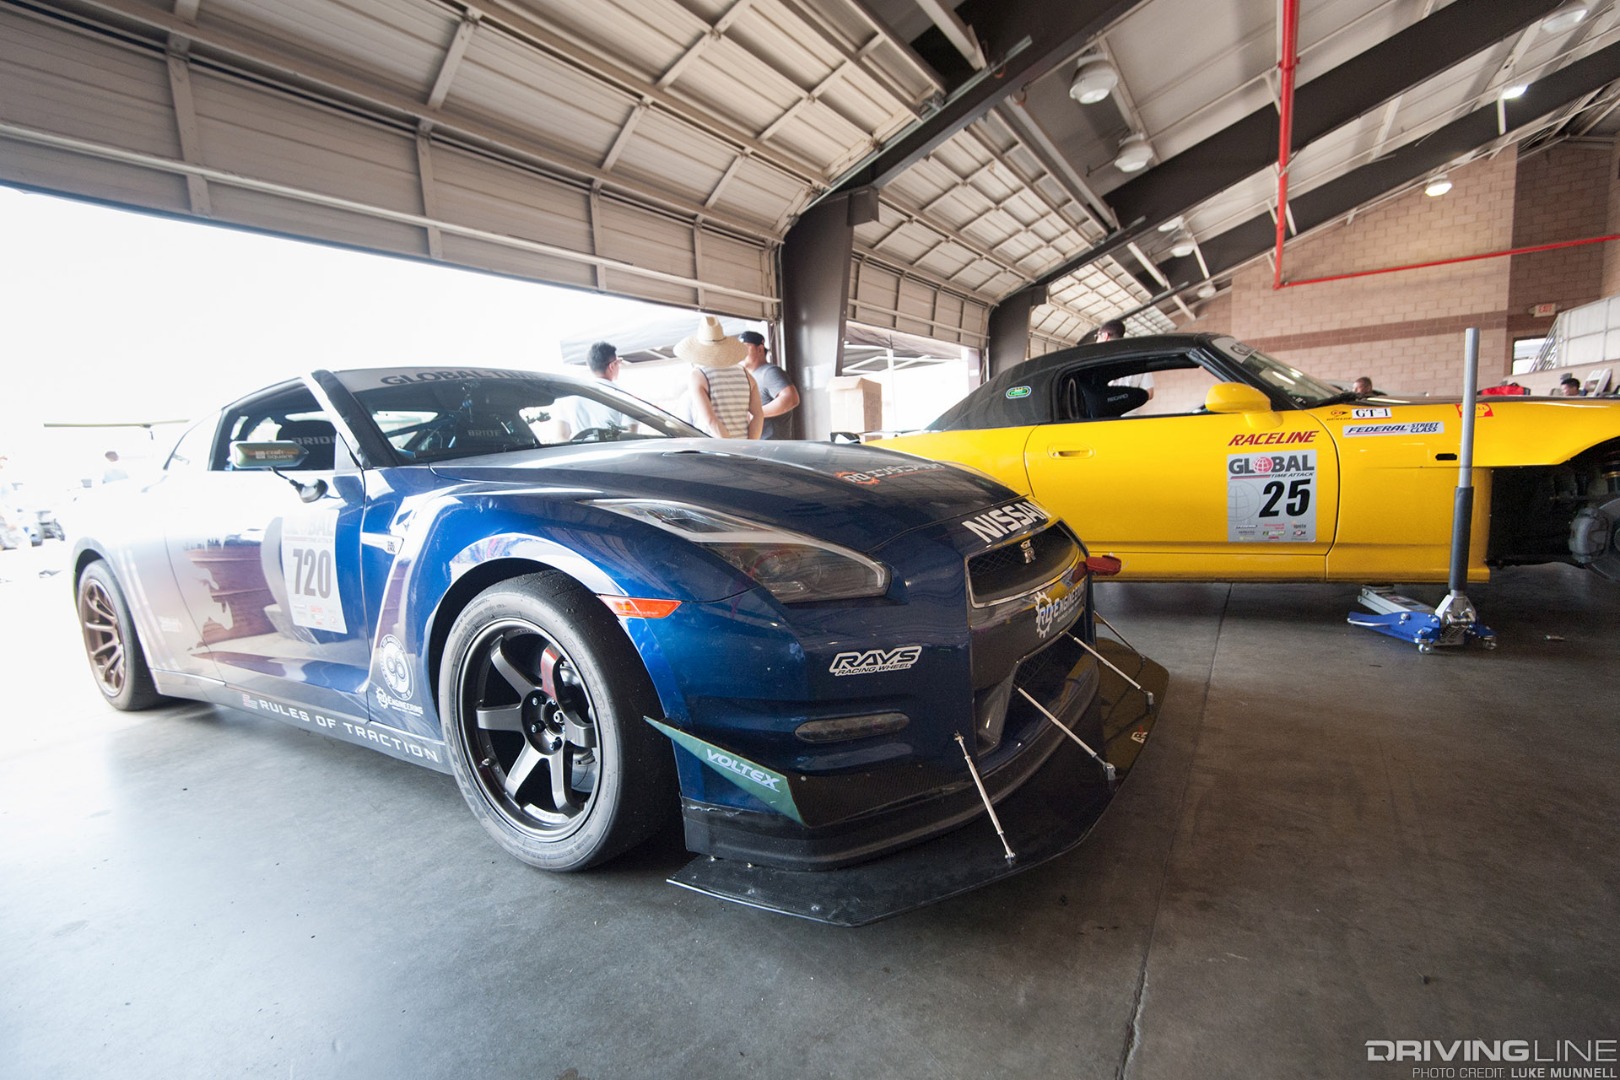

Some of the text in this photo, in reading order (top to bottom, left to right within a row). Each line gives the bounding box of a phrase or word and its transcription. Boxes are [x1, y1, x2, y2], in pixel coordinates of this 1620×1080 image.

[380, 370, 491, 385] GLOBAL
[1228, 430, 1319, 447] RACELINE
[1348, 424, 1408, 434] FEDERAL
[291, 436, 335, 446] BRID
[1228, 454, 1315, 475] GLOBAL
[1259, 479, 1311, 518] 25
[962, 501, 1053, 544] NISSAN
[293, 548, 332, 599] 720
[831, 647, 921, 671] RAYS
[837, 666, 877, 675] RACING
[258, 699, 439, 763] RULES OF TRACTION
[706, 748, 780, 790] VOLTEX
